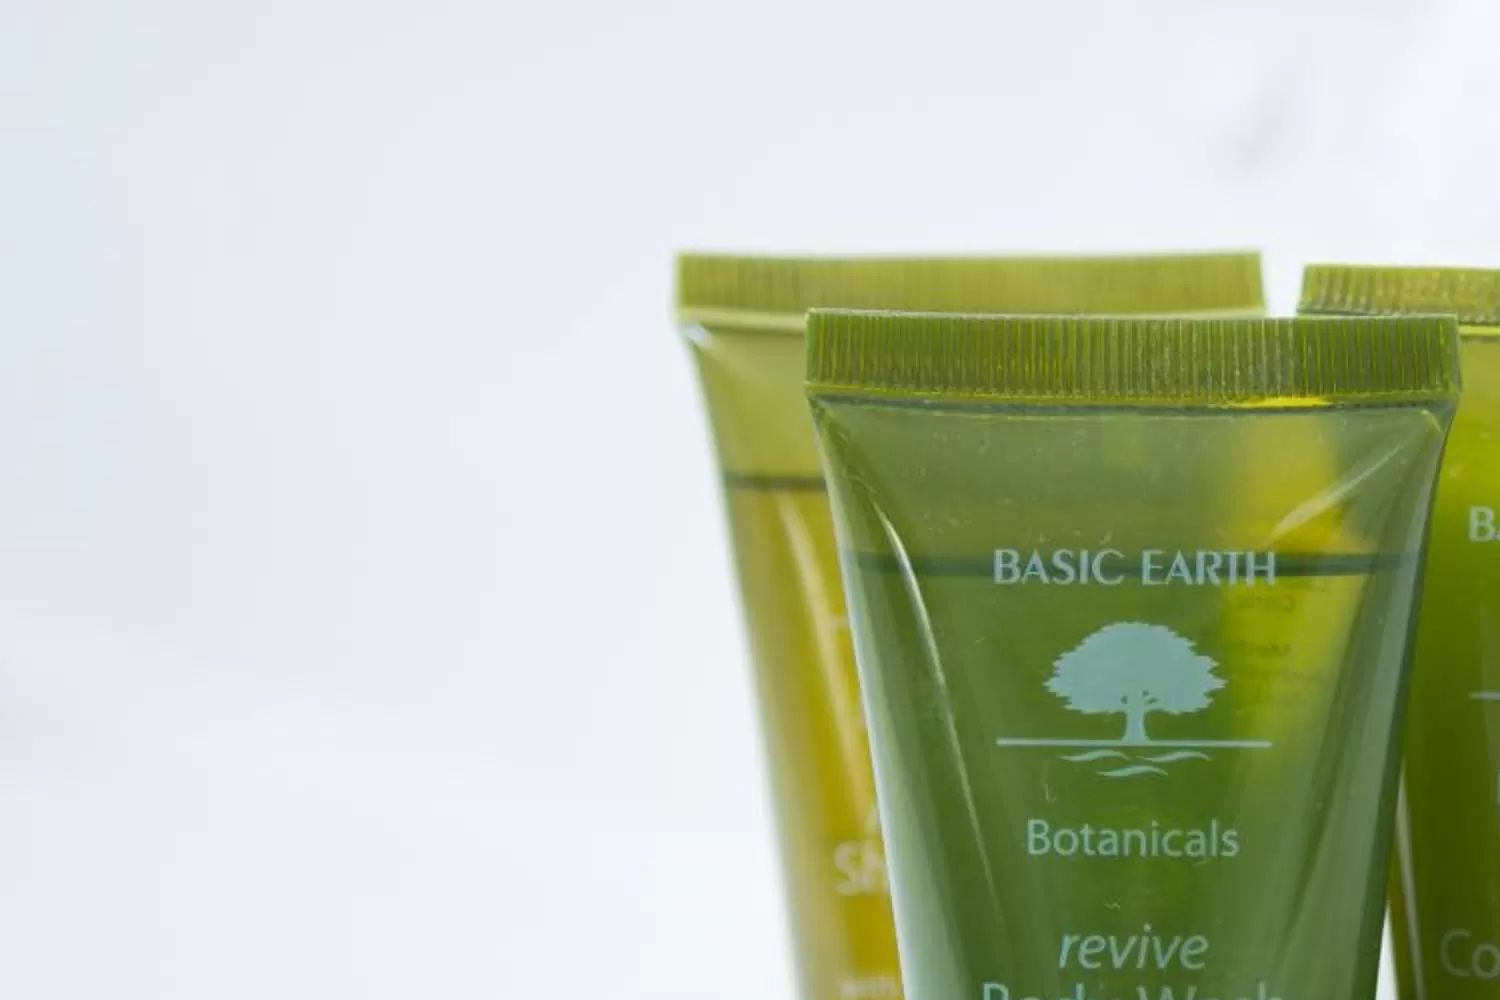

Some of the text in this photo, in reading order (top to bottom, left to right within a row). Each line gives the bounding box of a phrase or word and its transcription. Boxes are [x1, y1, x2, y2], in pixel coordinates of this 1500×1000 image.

[993, 547, 1277, 586] BASIC EARTH
[1027, 818, 1239, 857] Botanicals
[1058, 924, 1209, 970] revive
